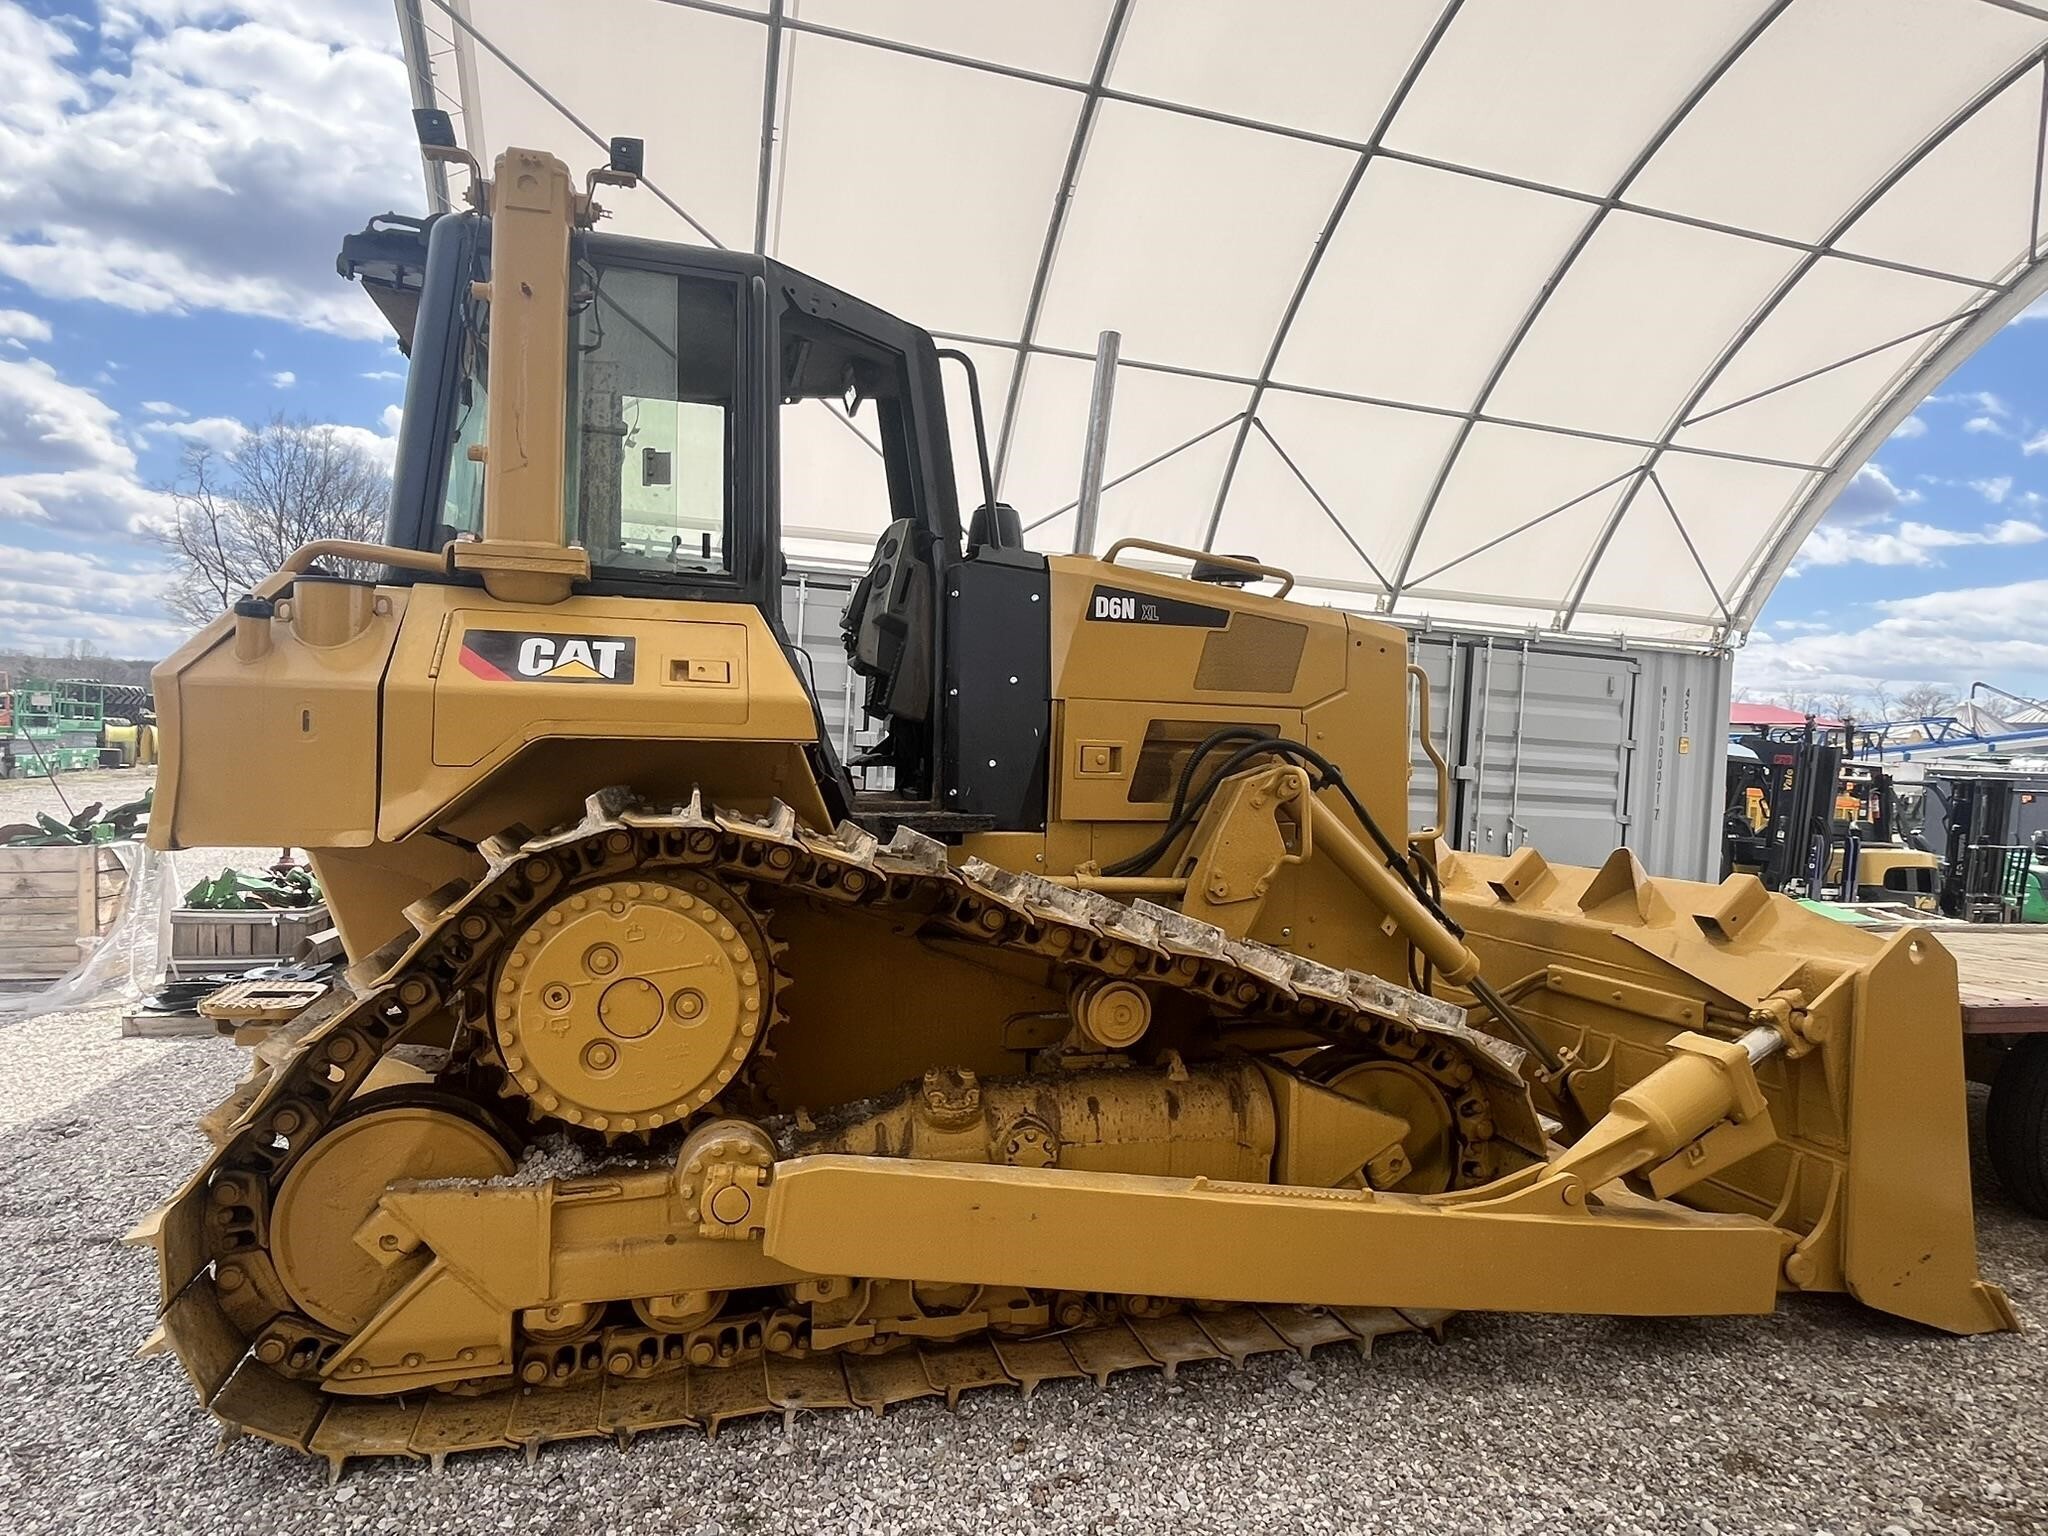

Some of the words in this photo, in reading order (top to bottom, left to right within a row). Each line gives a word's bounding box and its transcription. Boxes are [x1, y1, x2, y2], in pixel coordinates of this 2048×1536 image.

[1095, 596, 1135, 620] D6N
[1141, 604, 1160, 621] XL
[517, 637, 626, 680] CAT
